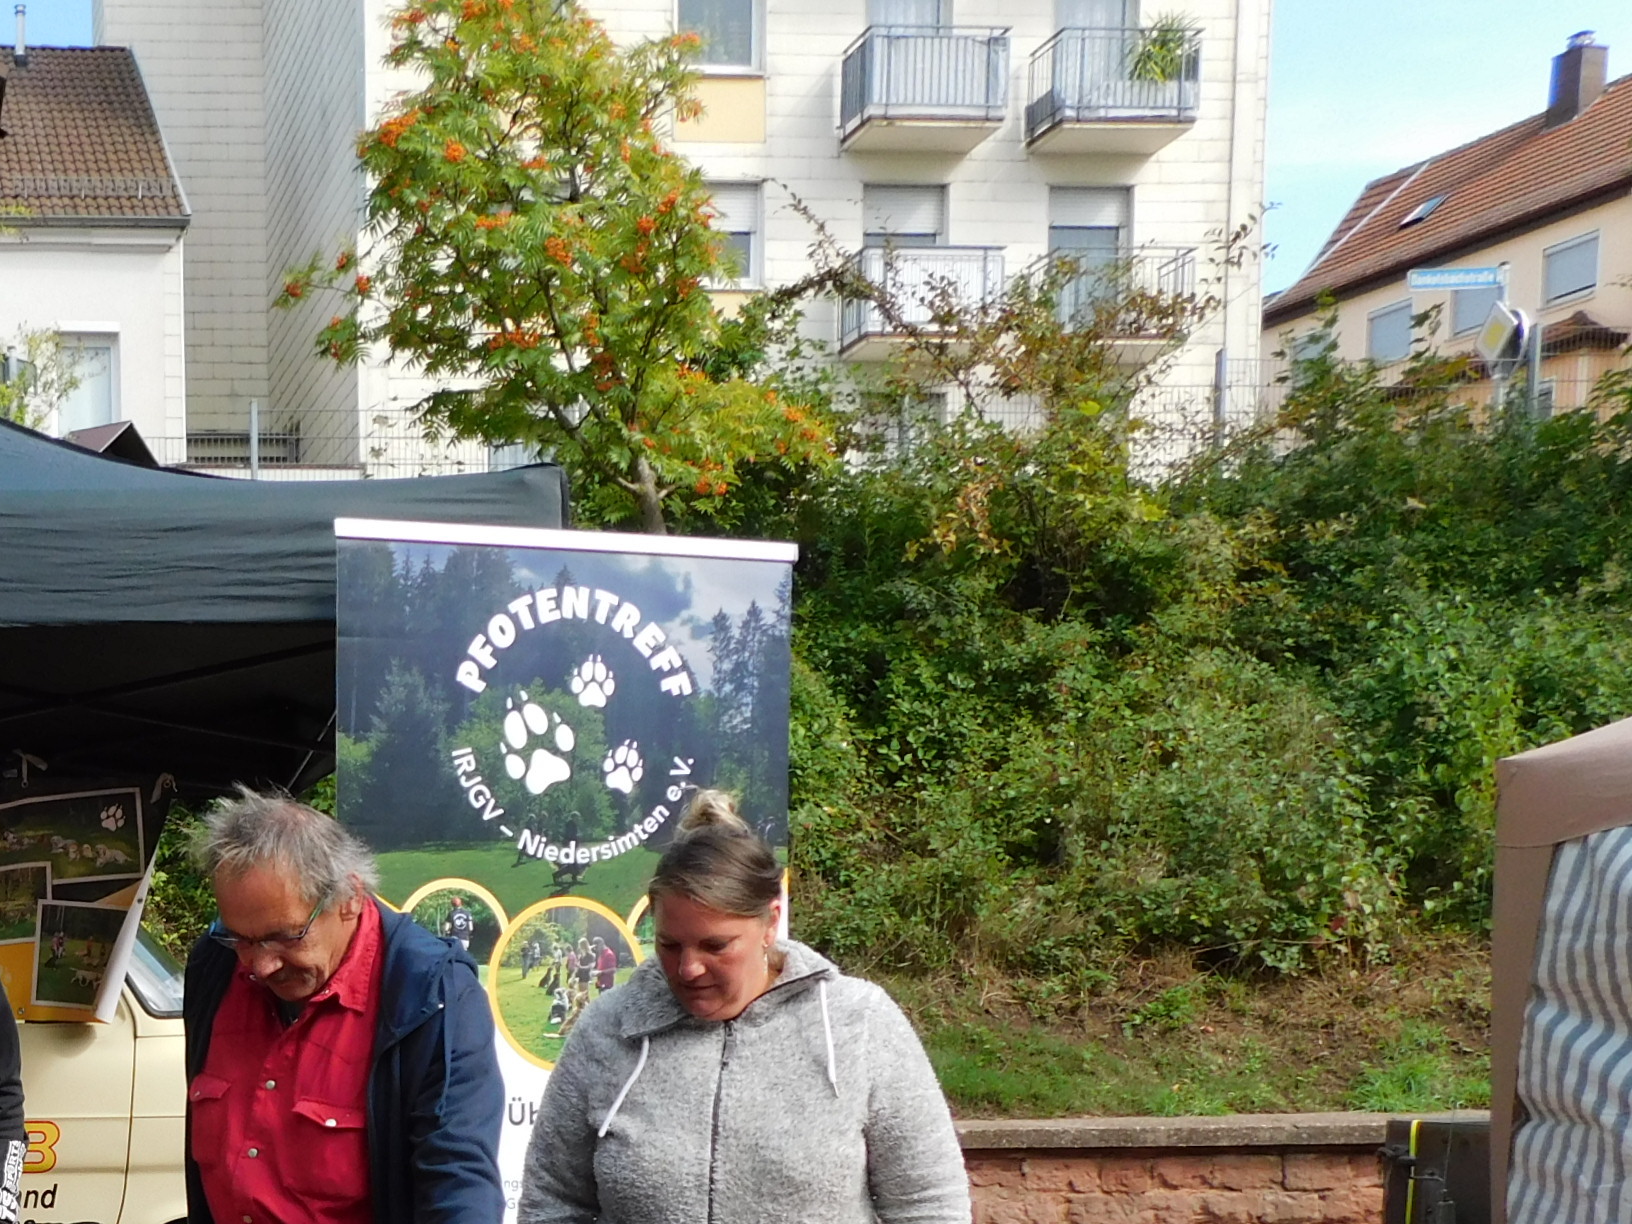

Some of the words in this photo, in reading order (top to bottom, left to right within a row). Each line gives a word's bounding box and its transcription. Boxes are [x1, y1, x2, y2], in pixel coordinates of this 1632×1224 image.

[456, 586, 693, 696] PFOTENTREFF
[451, 746, 505, 822] IRJGV
[517, 804, 670, 865] Niedersimten
